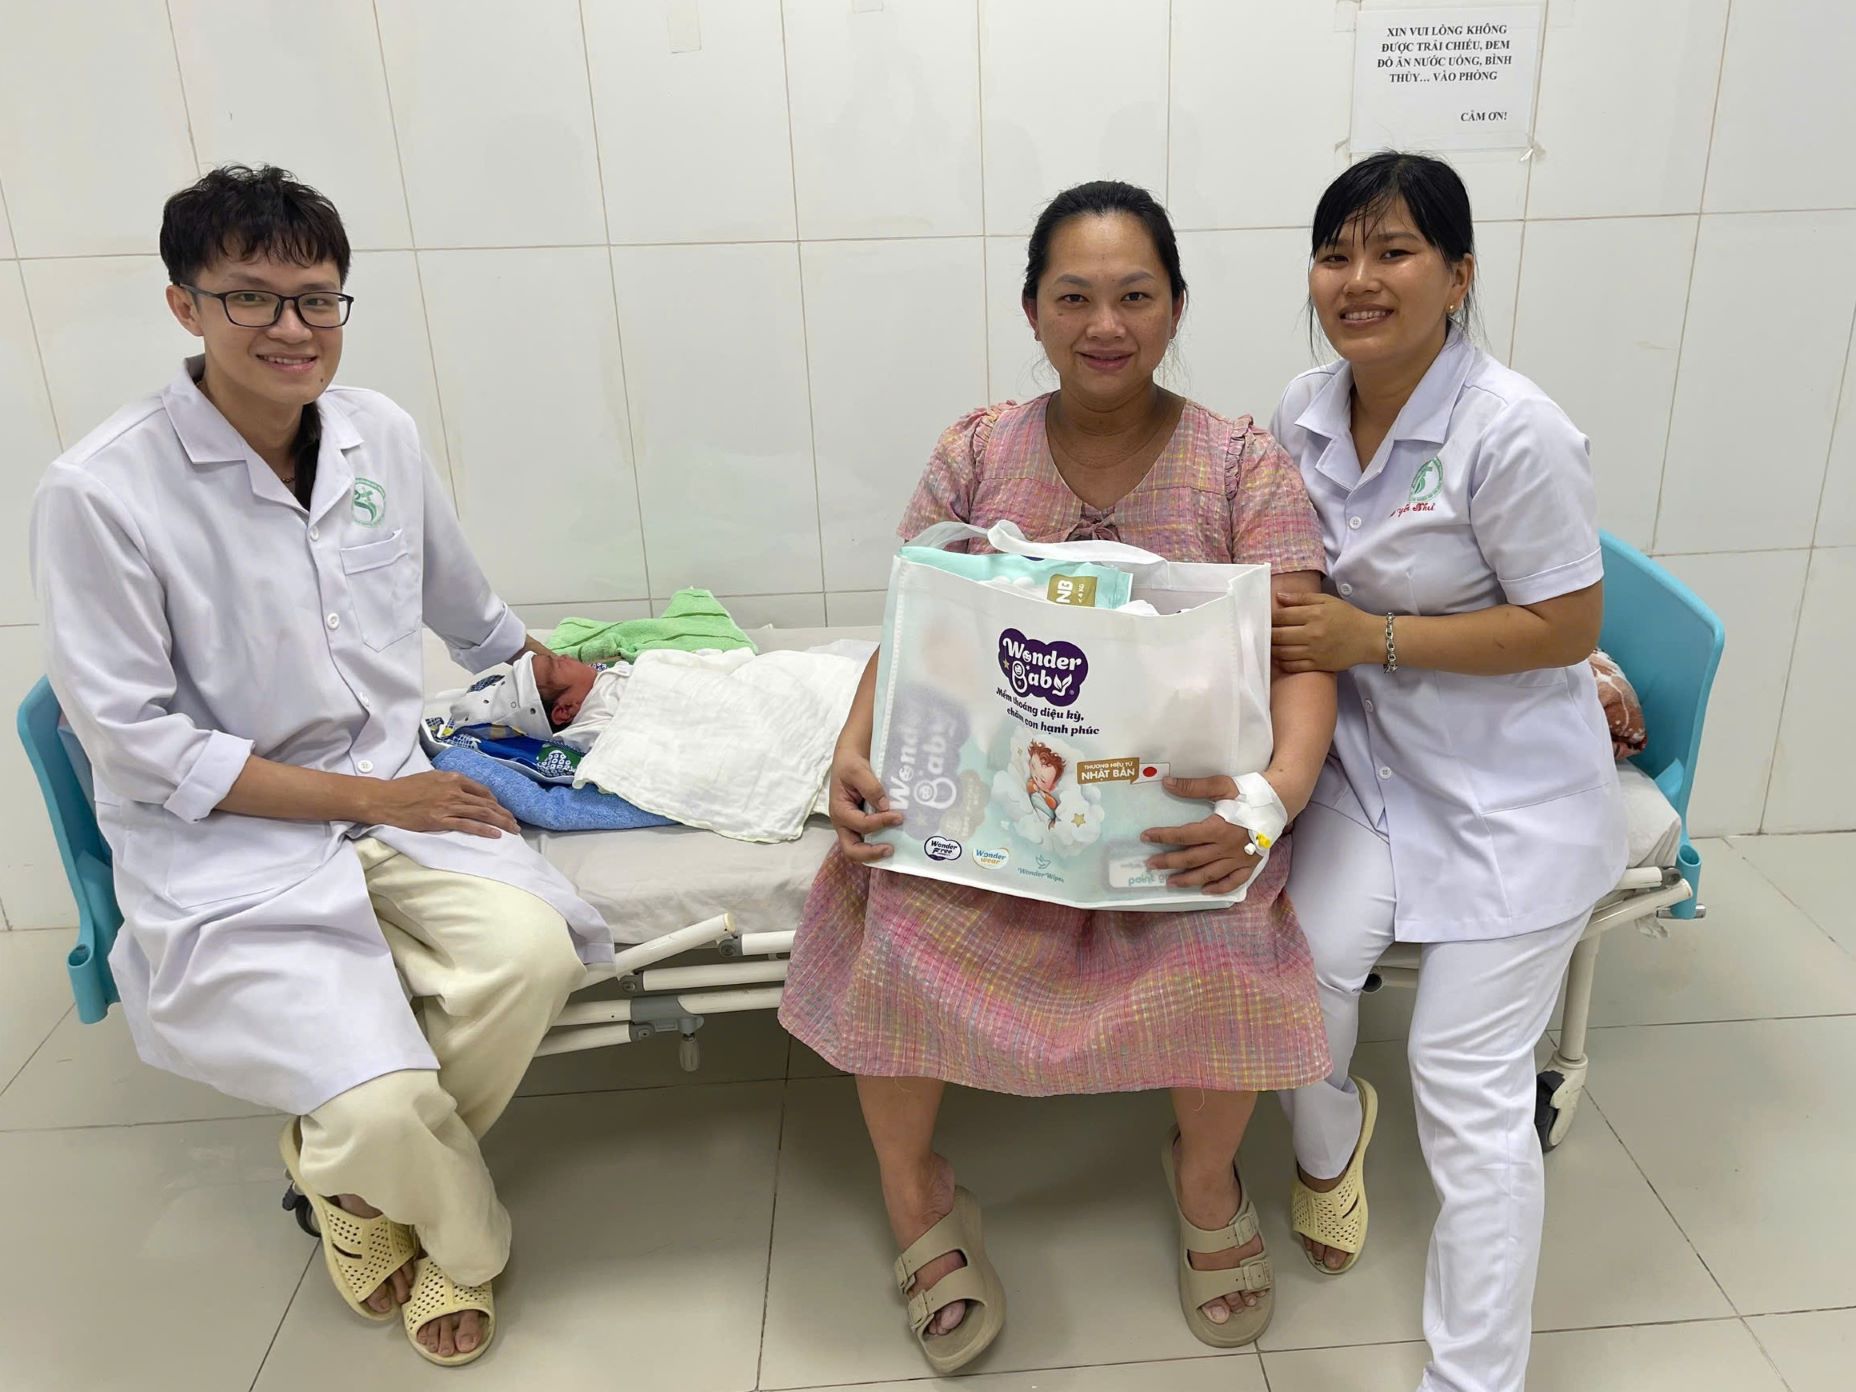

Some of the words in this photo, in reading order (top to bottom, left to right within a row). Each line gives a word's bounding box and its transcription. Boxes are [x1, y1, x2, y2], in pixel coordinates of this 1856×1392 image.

[1387, 27, 1406, 37] XIN
[1410, 27, 1428, 36] VUI
[1432, 24, 1462, 35] LÒNG
[1466, 23, 1507, 35] KHÔNG
[1382, 41, 1414, 54] ĐƯỢC
[1417, 40, 1443, 51] TRẢI
[1396, 56, 1411, 67] ĂN
[1414, 55, 1446, 67] NƯỚC
[1485, 53, 1512, 65] BÌNH
[1433, 70, 1456, 81] VÀO
[1459, 69, 1498, 81] PHÒNG
[1460, 109, 1485, 121] CẢM
[1488, 111, 1508, 121] ƠN!
[1056, 580, 1073, 604] NB
[1002, 638, 1082, 671] Wonder
[1012, 660, 1073, 697] Baby
[1040, 707, 1064, 720] diệu
[1024, 718, 1039, 730] con
[1040, 721, 1068, 735] hạnh
[1070, 725, 1100, 737] phúc
[1081, 767, 1111, 781] NHẬT
[1112, 767, 1135, 777] BẢN
[931, 840, 958, 850] Wonder
[976, 849, 1006, 860] Wonder
[980, 857, 1001, 865] wear
